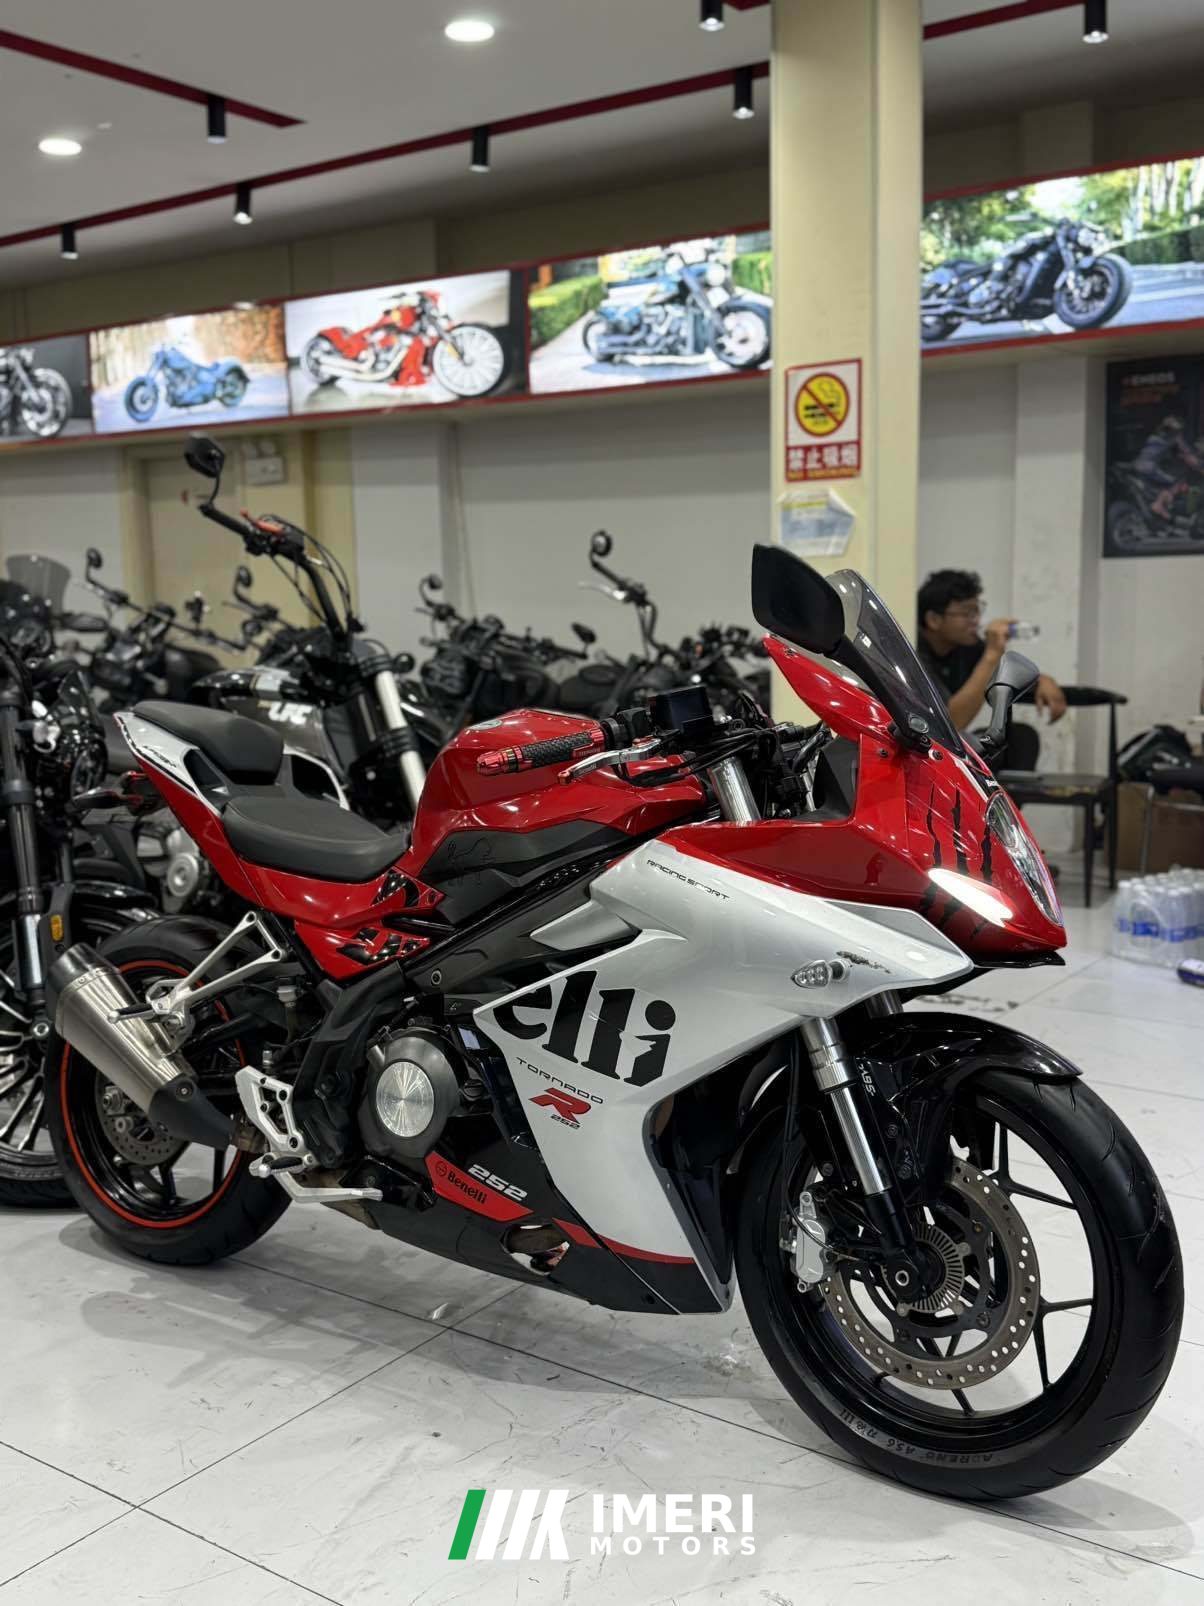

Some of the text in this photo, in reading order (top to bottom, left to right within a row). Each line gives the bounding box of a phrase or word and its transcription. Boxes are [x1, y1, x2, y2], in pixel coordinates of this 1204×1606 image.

[646, 859, 730, 900] RACING SPORT
[516, 1056, 604, 1105] TORNADO
[528, 1087, 592, 1124] R
[550, 1113, 581, 1131] 252
[447, 1170, 488, 1205] Benelli
[467, 1163, 529, 1202] 252
